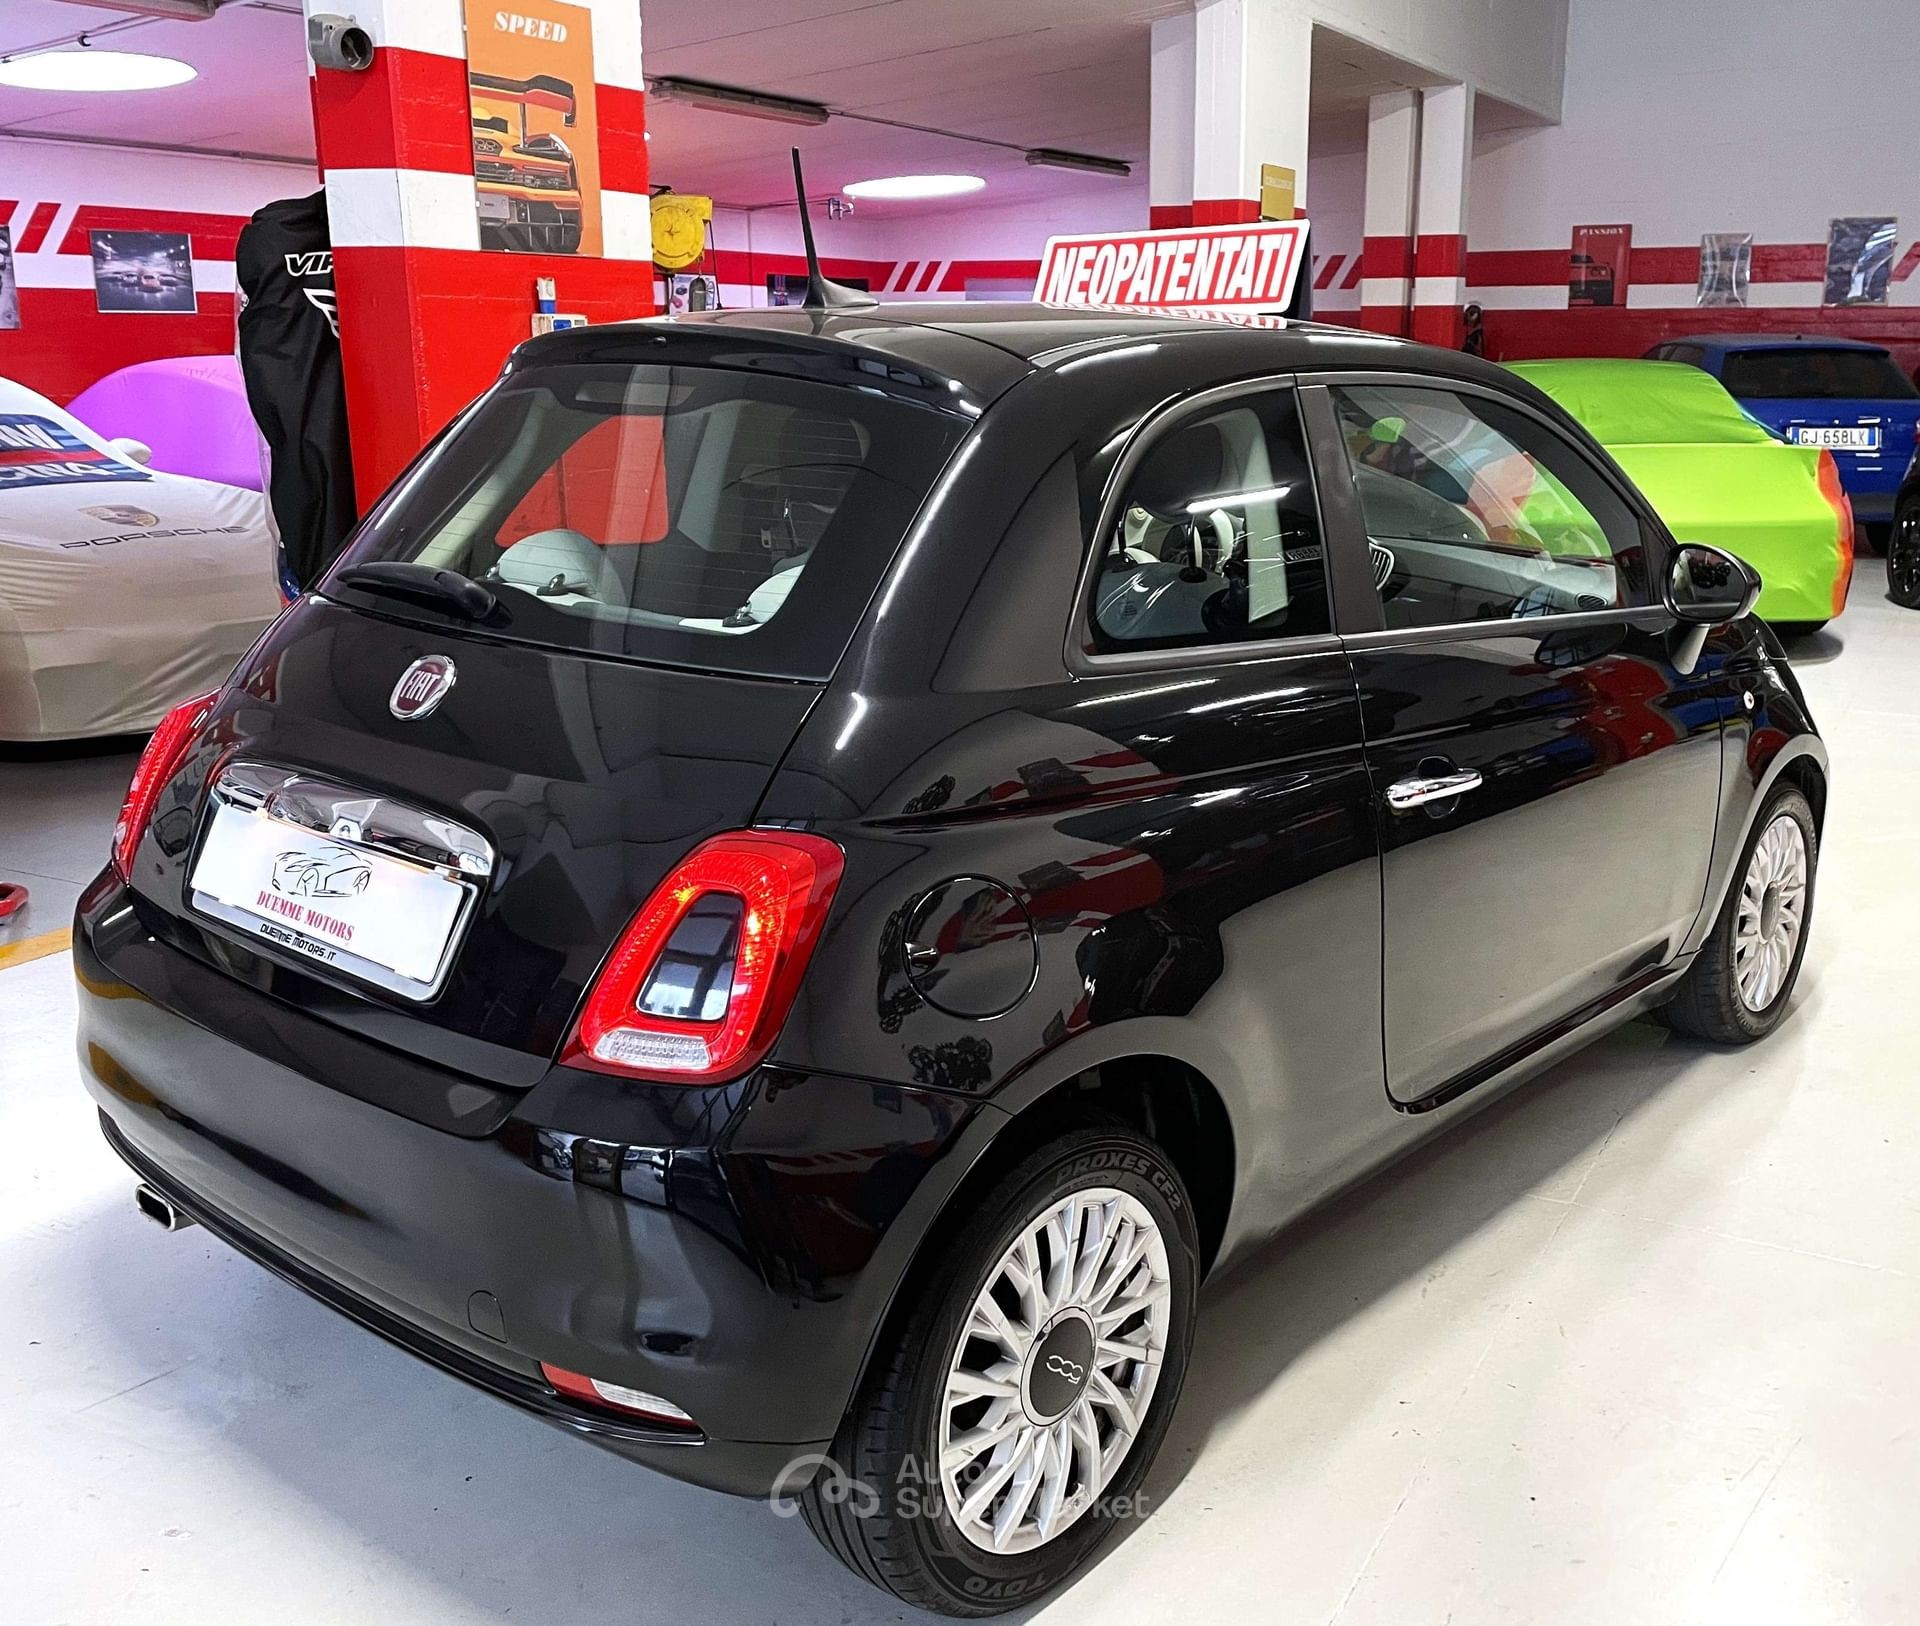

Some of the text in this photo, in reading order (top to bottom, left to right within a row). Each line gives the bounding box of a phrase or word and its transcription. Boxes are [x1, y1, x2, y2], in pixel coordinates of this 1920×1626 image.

[493, 11, 568, 42] SPEED
[1051, 233, 1294, 304] NEOPATENTATI
[1801, 430, 1818, 444] GJ
[59, 526, 250, 548] PORSCHE
[399, 670, 441, 702] FIAT
[256, 890, 356, 941] DUEMME MOTORS
[1055, 1151, 1151, 1187] PROXES
[1151, 1170, 1182, 1211] CF2
[963, 1573, 1047, 1598] TOYO
